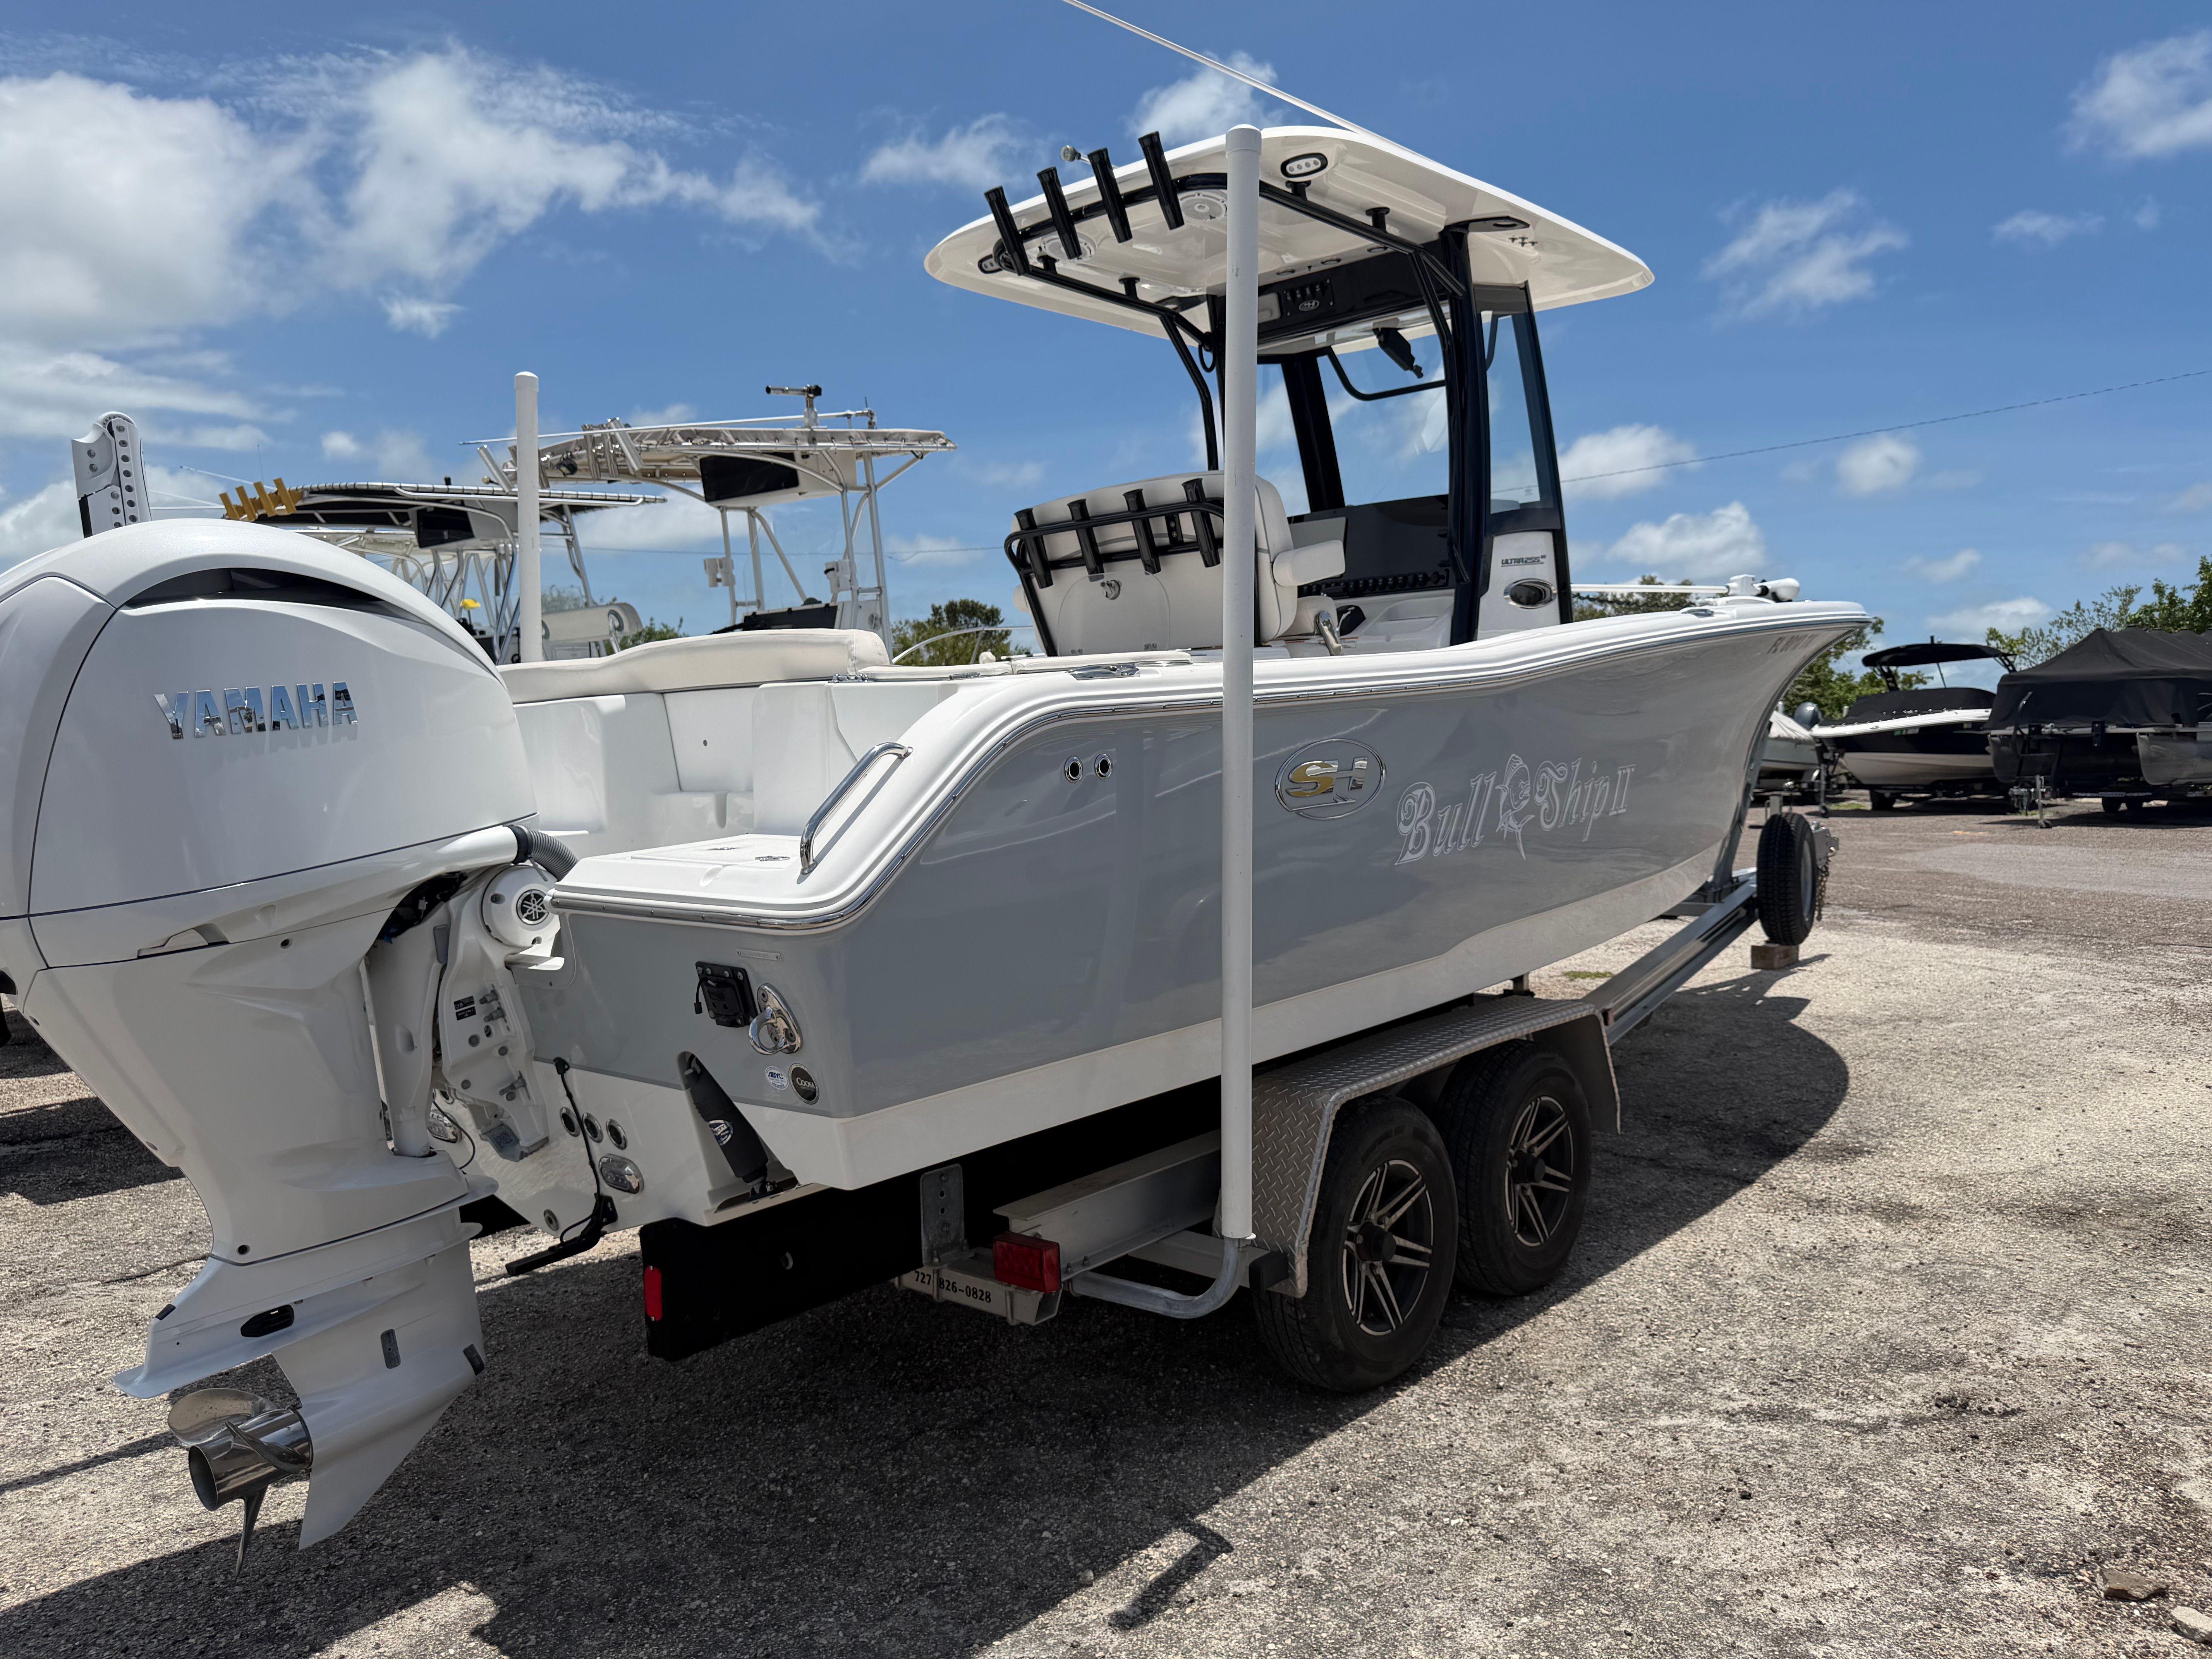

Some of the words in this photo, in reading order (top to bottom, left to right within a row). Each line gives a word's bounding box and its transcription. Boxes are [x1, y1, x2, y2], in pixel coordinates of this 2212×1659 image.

[153, 681, 359, 740] YAMAHA
[1285, 756, 1368, 798] SH
[1395, 771, 1497, 865] Bull
[1608, 764, 1637, 816] II
[914, 1270, 931, 1285] 727
[938, 1277, 991, 1303] 826-0828
